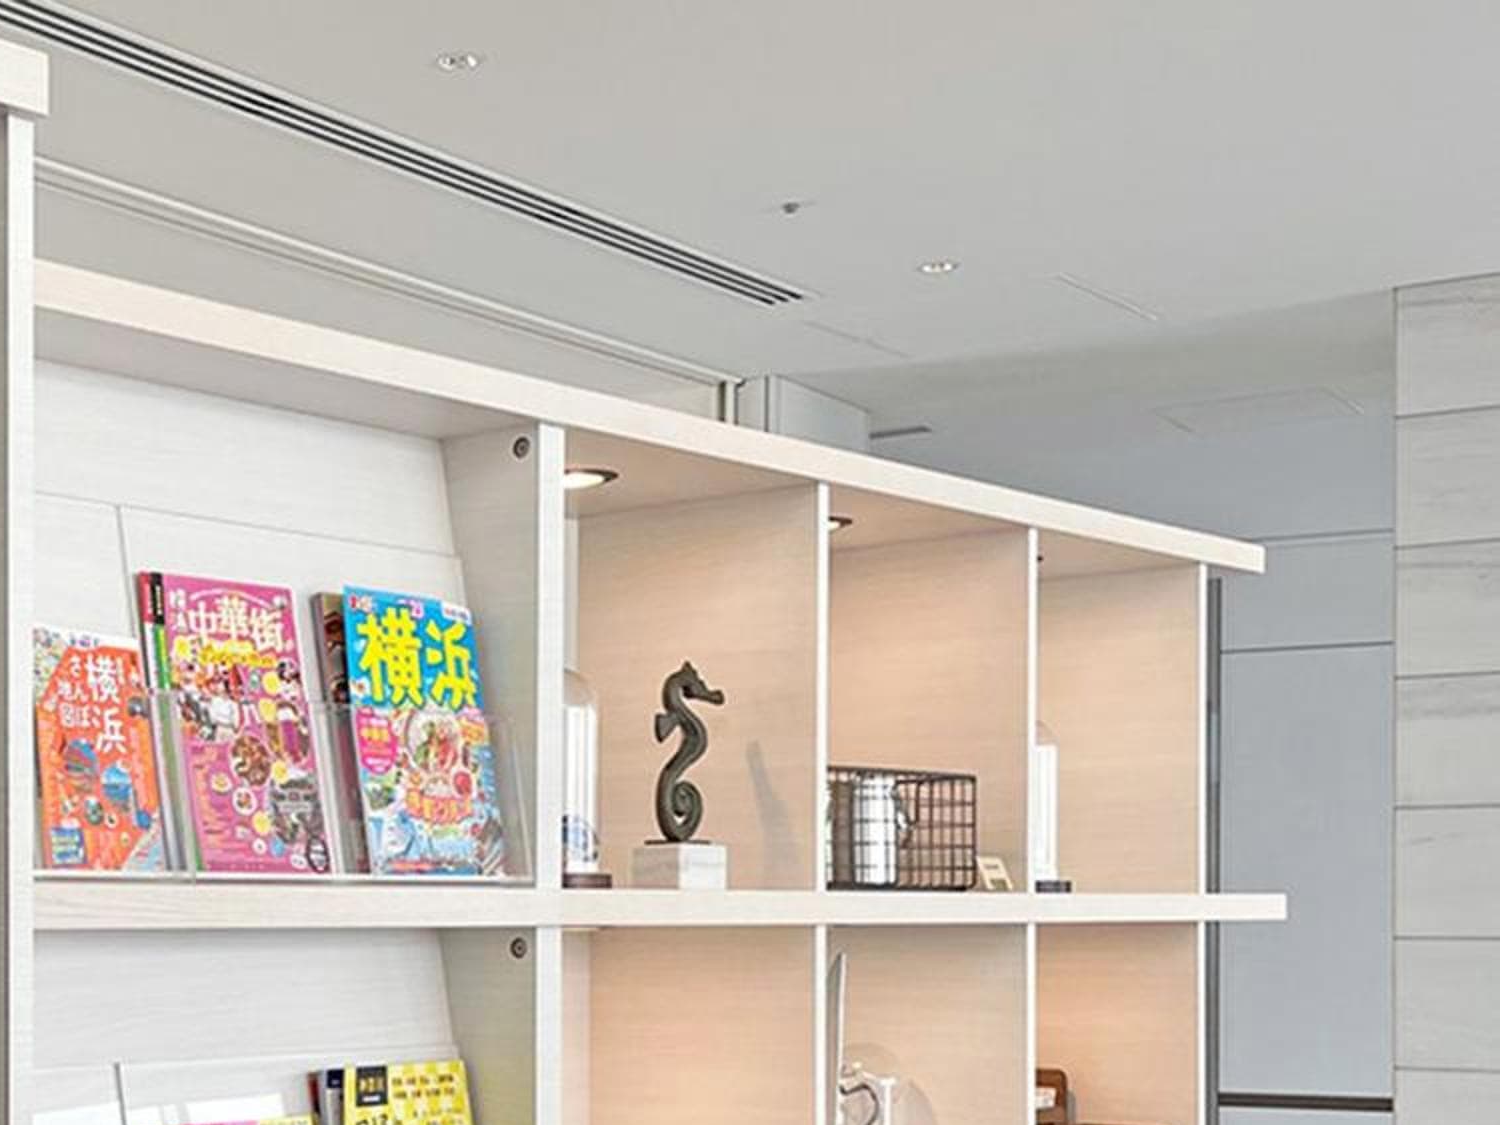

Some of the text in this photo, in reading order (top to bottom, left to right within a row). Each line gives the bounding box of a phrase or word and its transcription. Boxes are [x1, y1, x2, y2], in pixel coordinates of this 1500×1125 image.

[188, 592, 284, 652] 中華街
[356, 606, 477, 710] 横浜
[86, 653, 127, 753] 横浜
